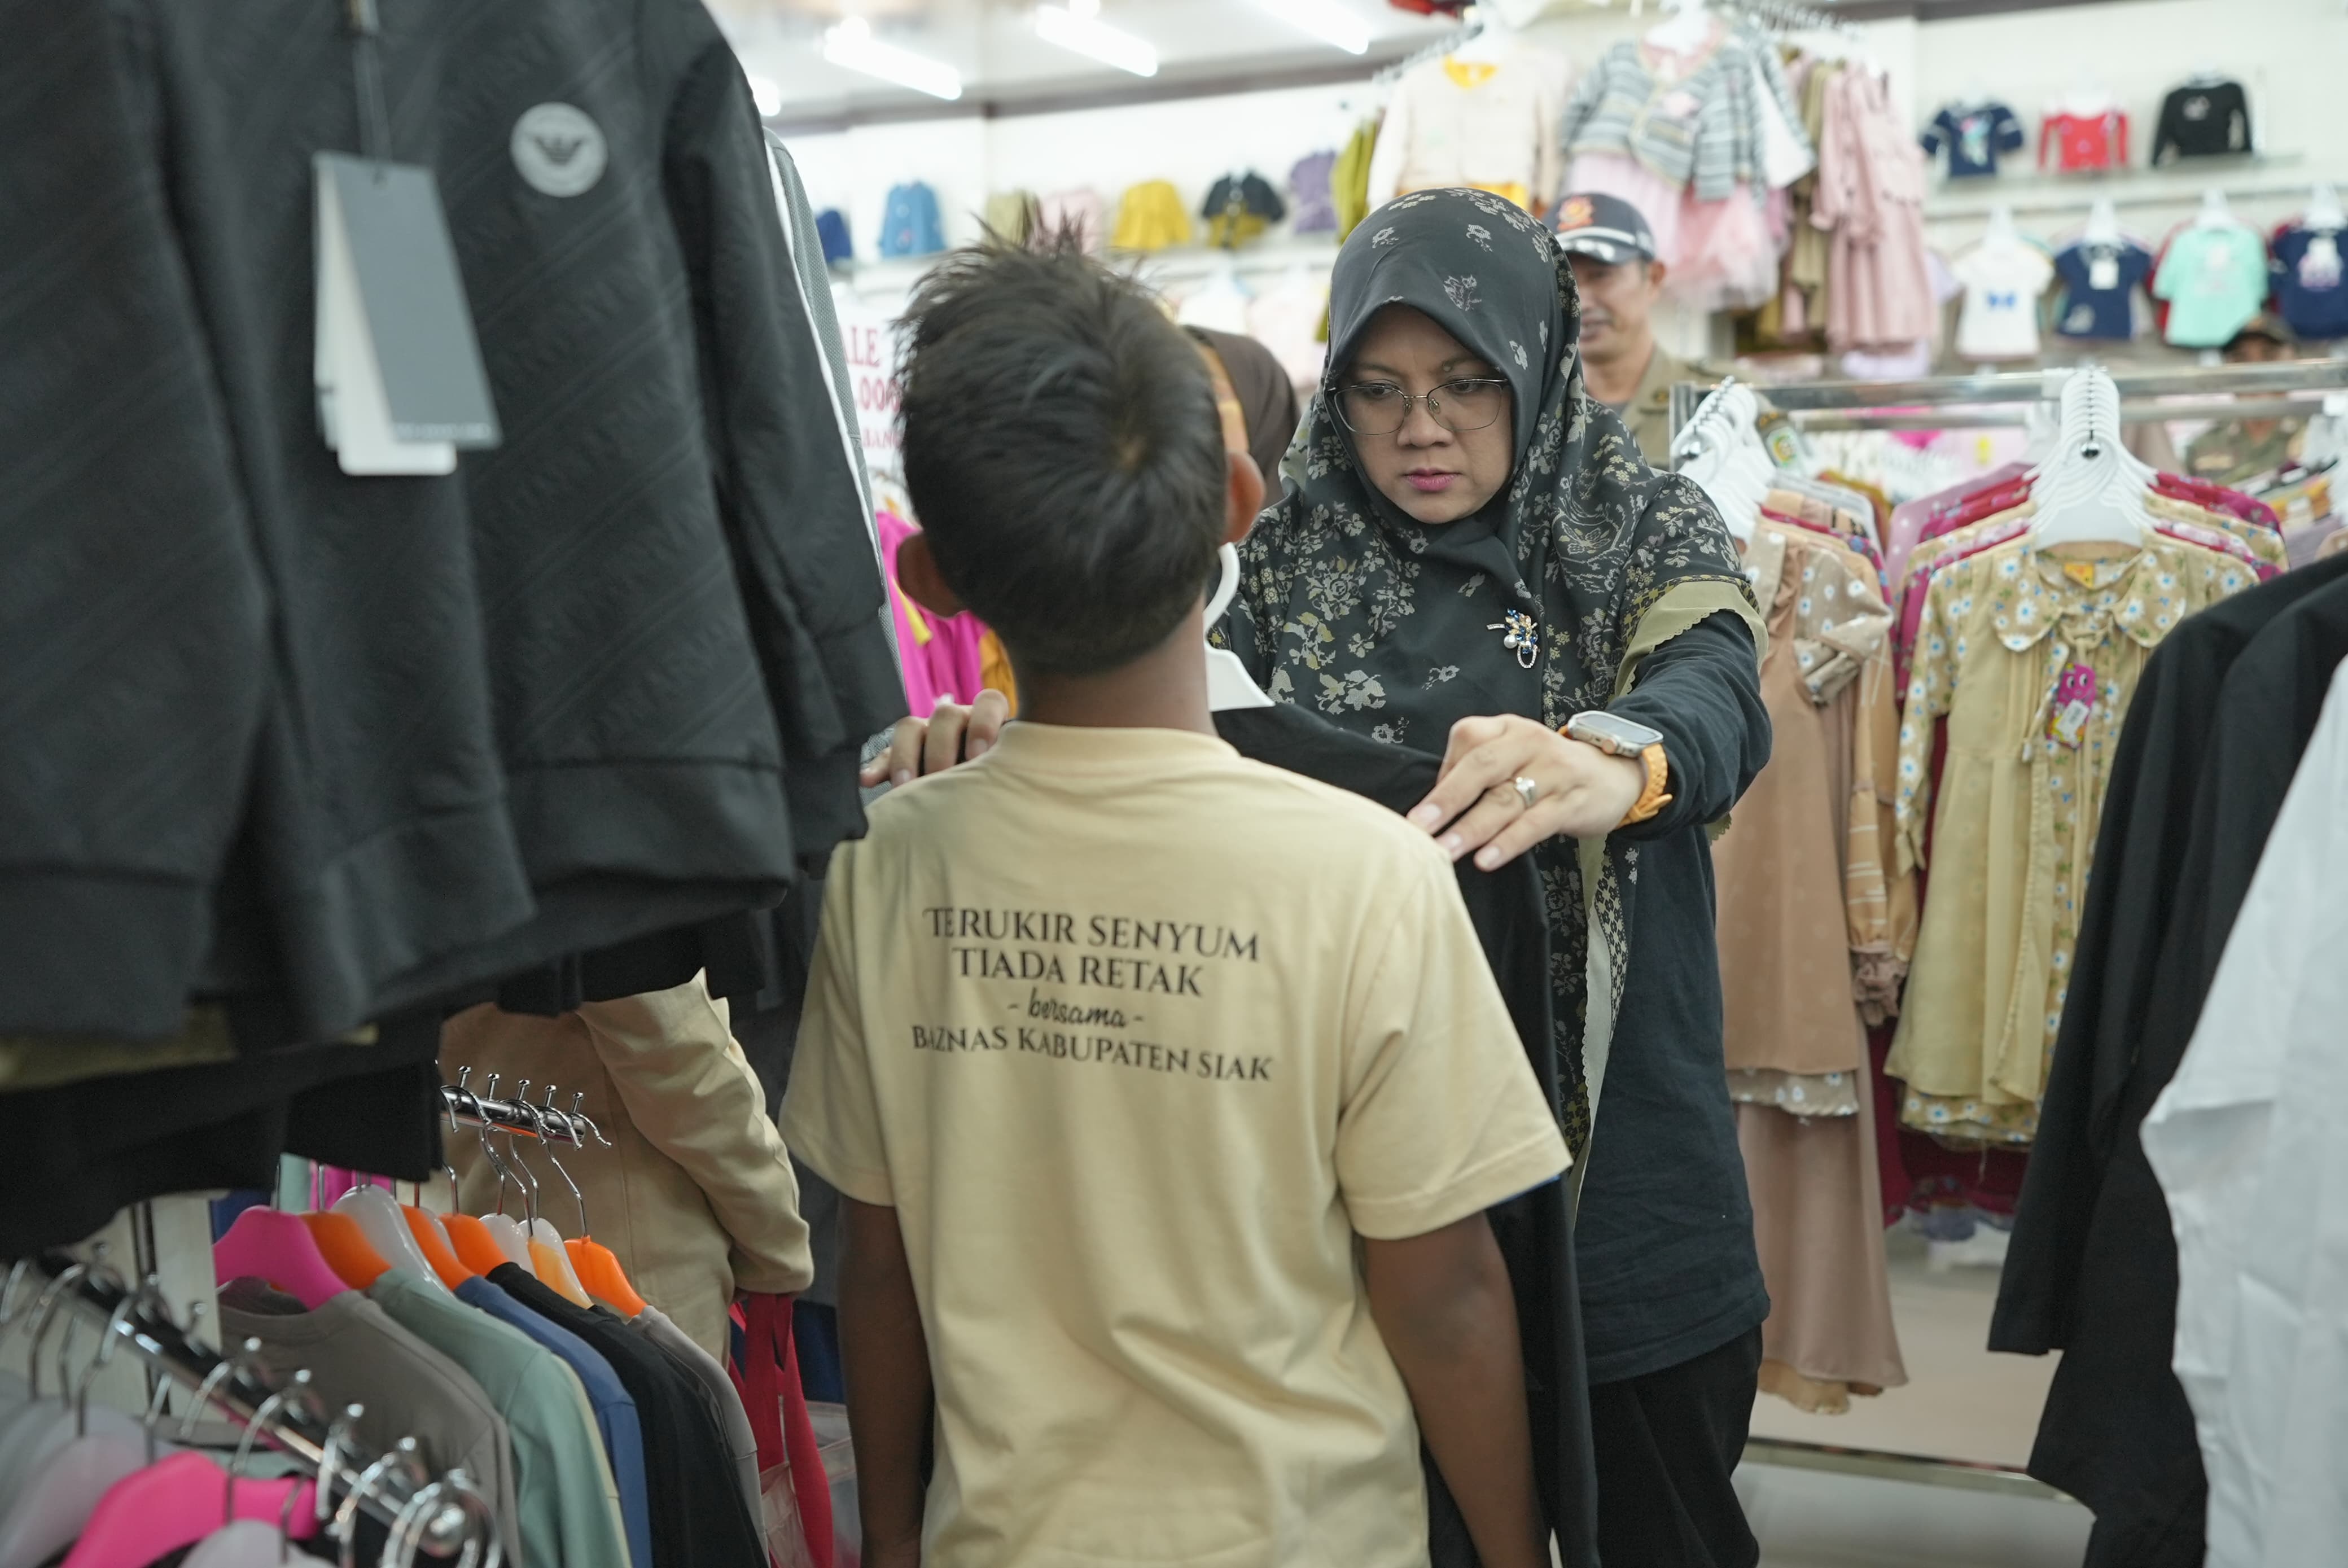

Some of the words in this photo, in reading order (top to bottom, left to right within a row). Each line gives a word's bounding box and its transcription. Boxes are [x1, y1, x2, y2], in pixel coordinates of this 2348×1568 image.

[846, 326, 880, 367] LE
[922, 906, 1078, 945] TERUKIR
[1087, 914, 1259, 962] SENYUM
[952, 947, 1066, 984] TIADA
[1080, 955, 1203, 997] RETAK
[912, 1024, 1008, 1052] BAZNAS
[1017, 1026, 1189, 1074] KABUPATEN
[1196, 1050, 1273, 1080] SIAK
